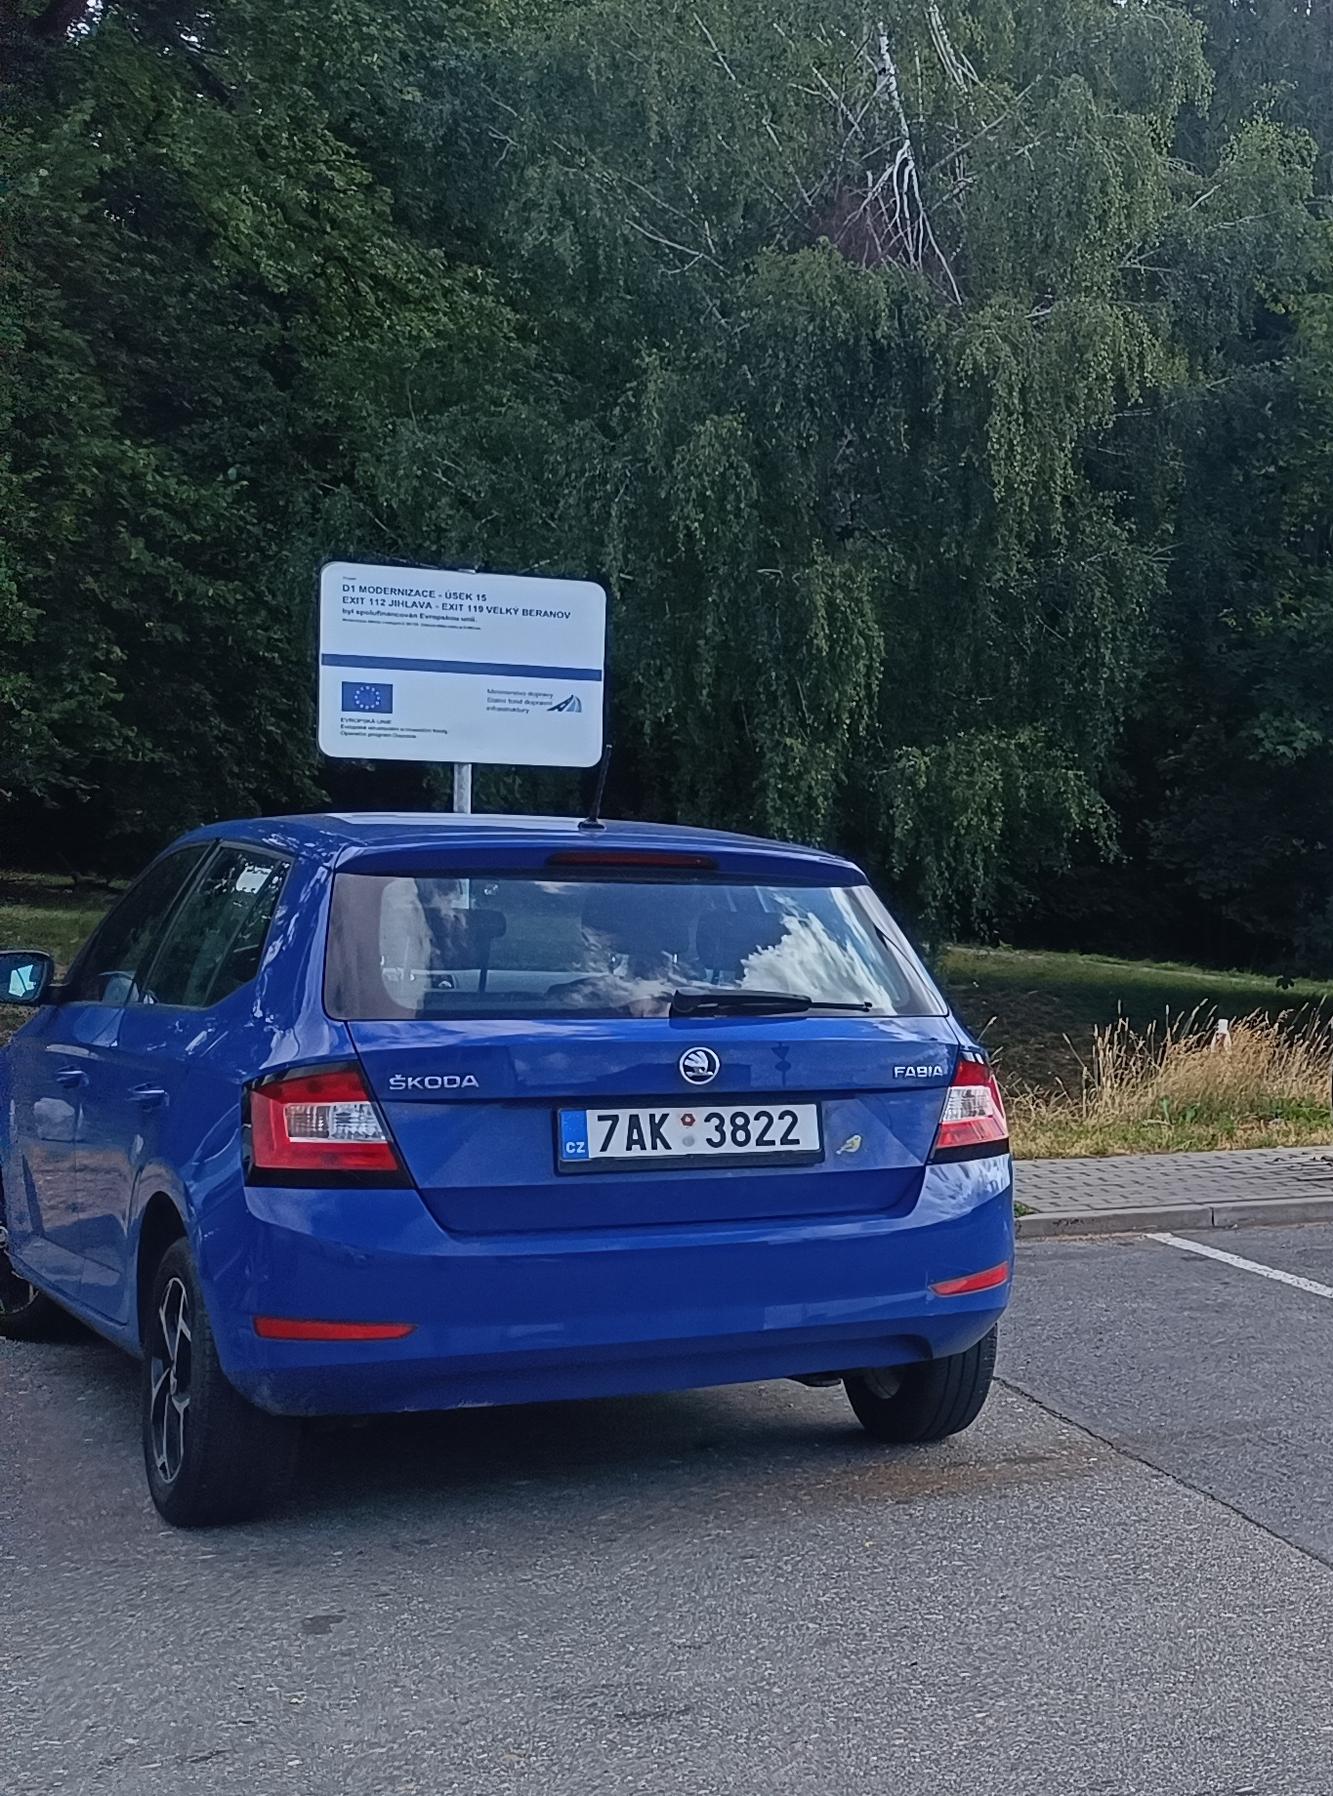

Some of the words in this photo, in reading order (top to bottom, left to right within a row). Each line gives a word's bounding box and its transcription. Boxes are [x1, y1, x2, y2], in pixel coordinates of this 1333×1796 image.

[342, 584, 355, 593] D1
[359, 585, 436, 598] MODERNIZACE
[444, 589, 473, 601] ÚSEK
[476, 594, 487, 602] 15
[342, 596, 366, 605] EXIT
[369, 598, 386, 606] 112
[388, 599, 433, 610] JIHLAVA
[441, 602, 464, 612] EXIT
[468, 605, 484, 613] 119
[522, 608, 571, 619] BERANOV
[894, 1065, 943, 1078] FABIA
[389, 1074, 479, 1090] ŠKODA
[597, 1113, 672, 1152] 7AK
[703, 1110, 800, 1148] 3822
[565, 1141, 585, 1153] CZ
